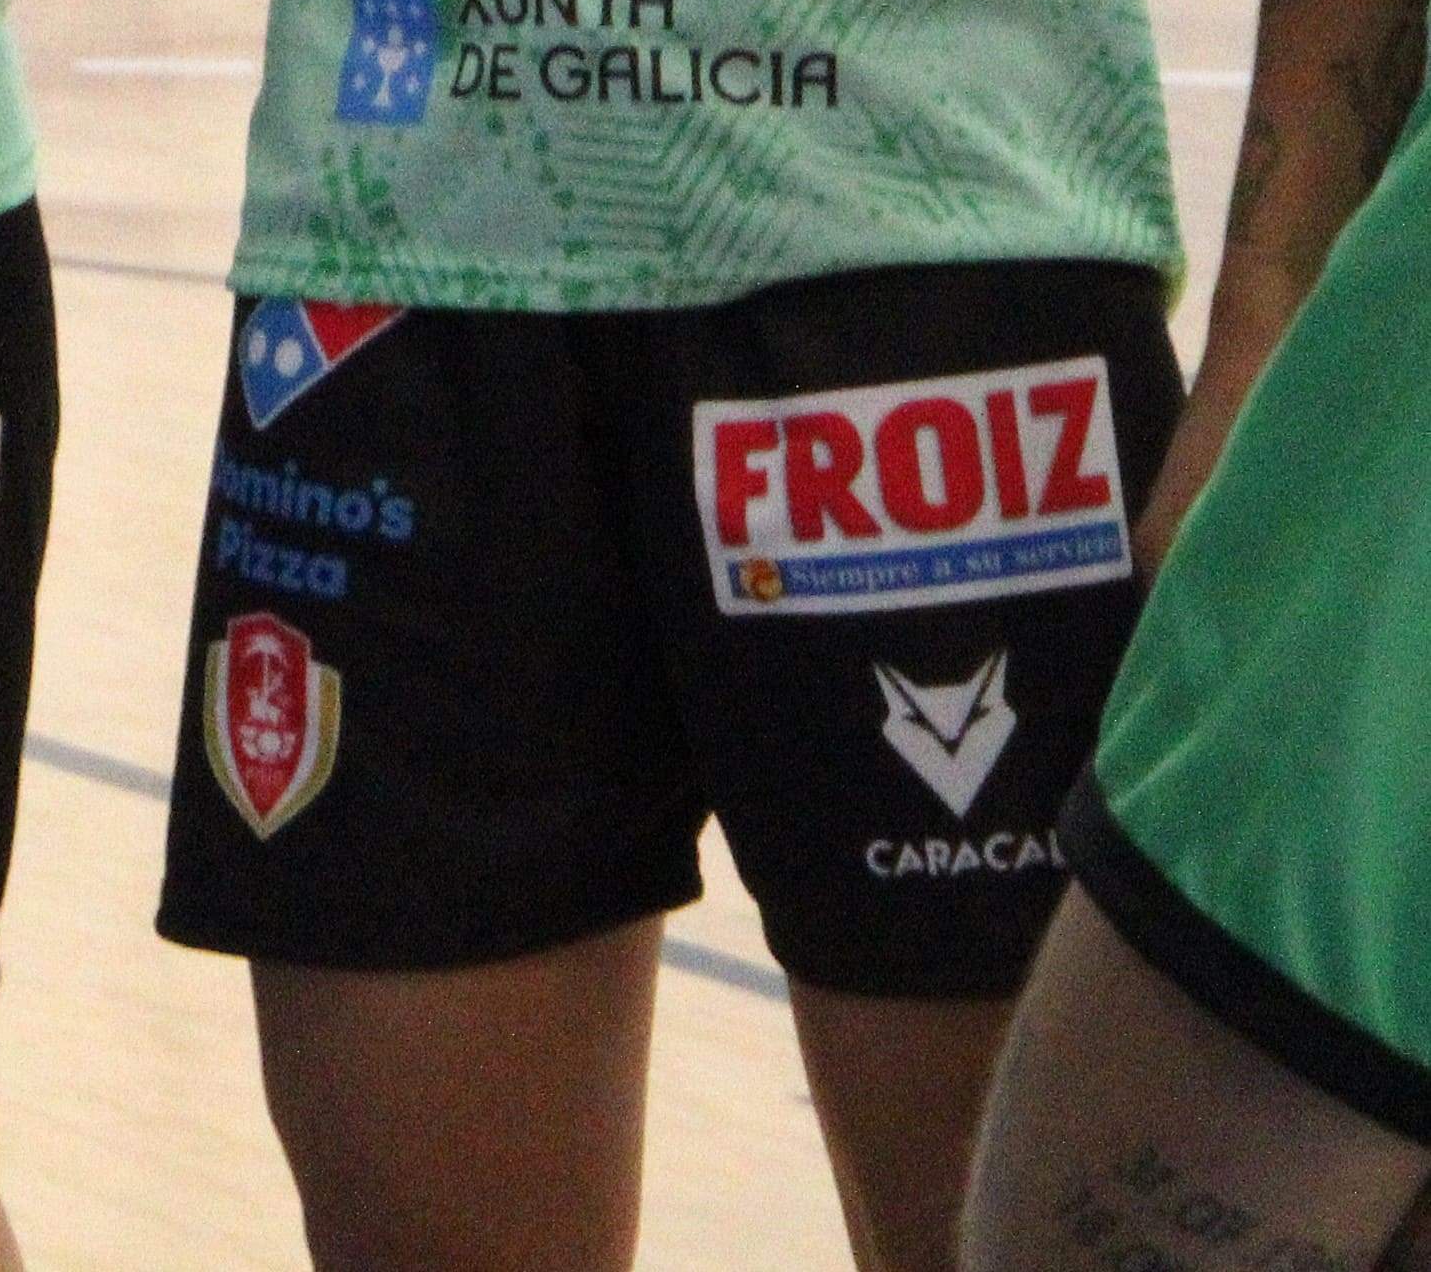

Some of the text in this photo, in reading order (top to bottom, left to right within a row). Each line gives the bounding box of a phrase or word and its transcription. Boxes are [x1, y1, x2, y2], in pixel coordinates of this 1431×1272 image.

[448, 44, 840, 109] DE GALICIA
[715, 377, 1111, 547] FROIZ
[218, 517, 348, 600] Pizza
[788, 551, 921, 593] Siempre
[933, 555, 952, 577] a
[966, 548, 1002, 574] su
[865, 828, 1065, 877] CARACAL
